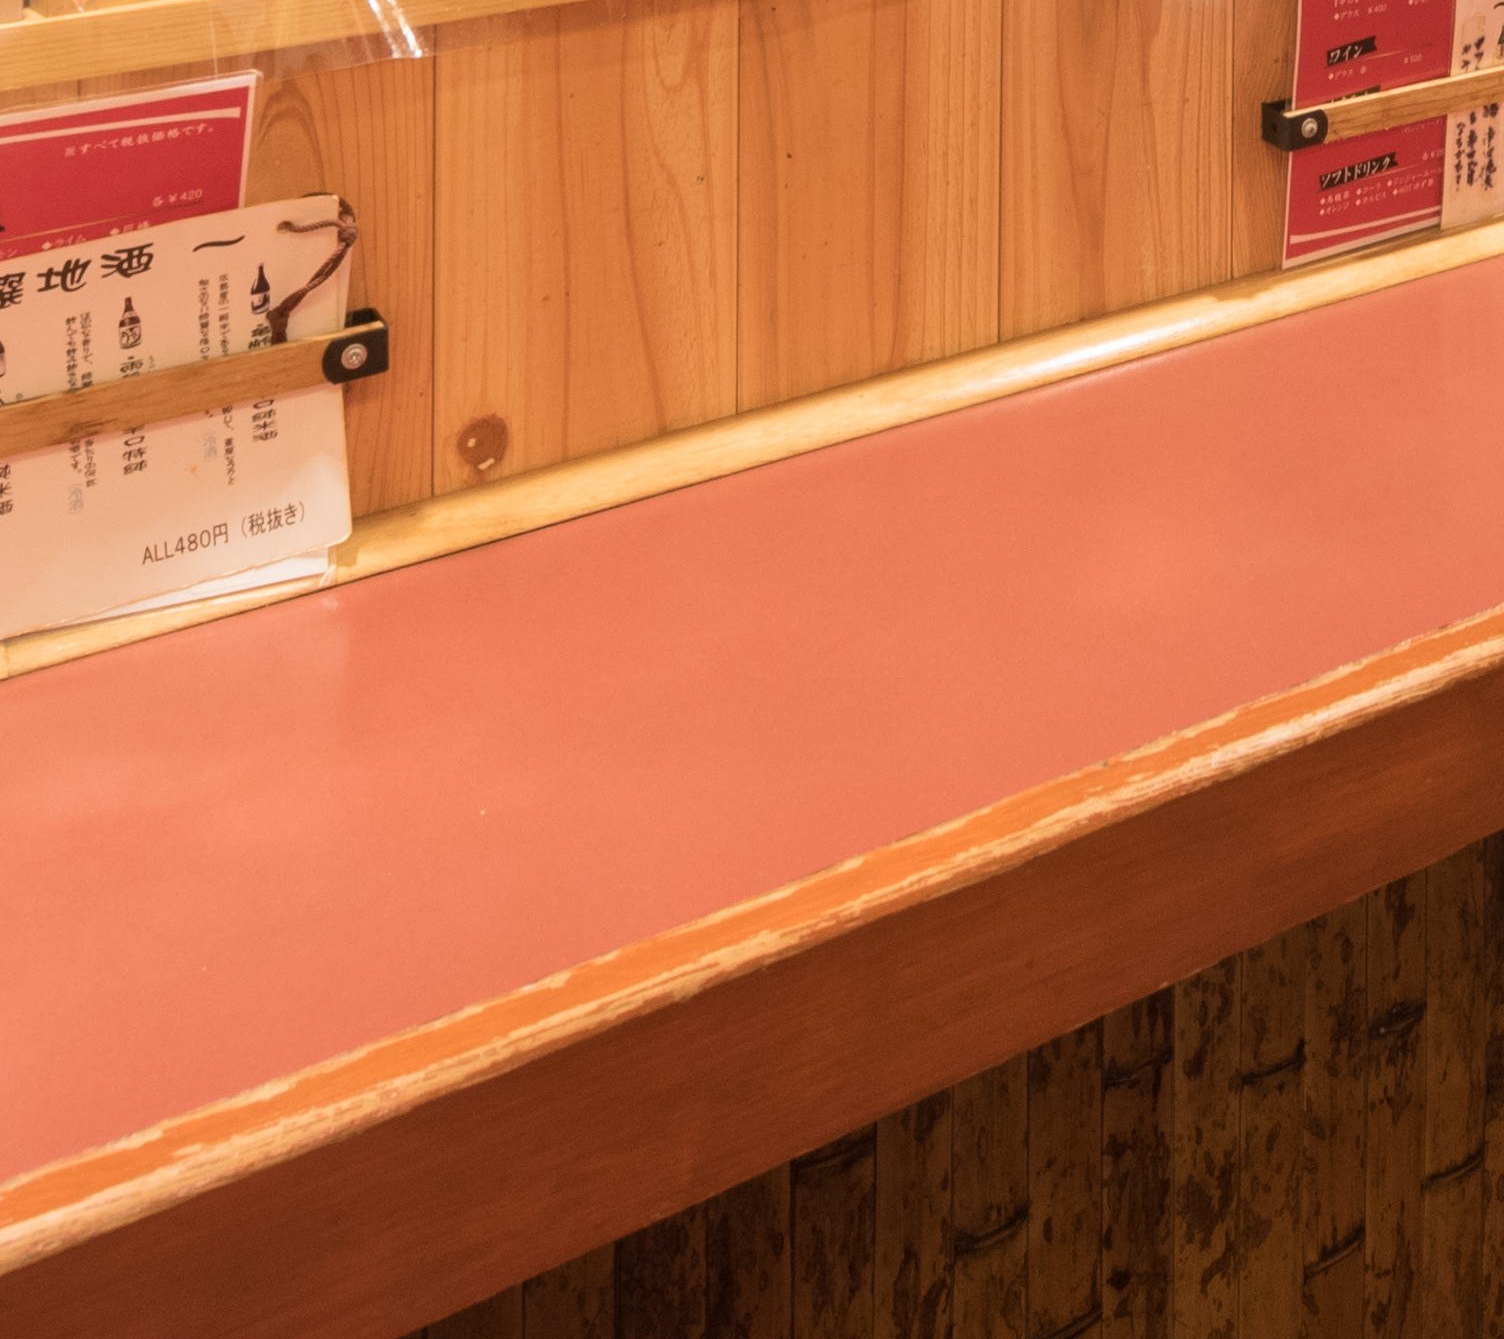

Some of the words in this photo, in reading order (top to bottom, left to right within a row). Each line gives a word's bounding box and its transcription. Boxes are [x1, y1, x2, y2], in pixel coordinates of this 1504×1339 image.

[1329, 44, 1364, 64] ワイン
[1320, 157, 1391, 187] ソフトドリンク
